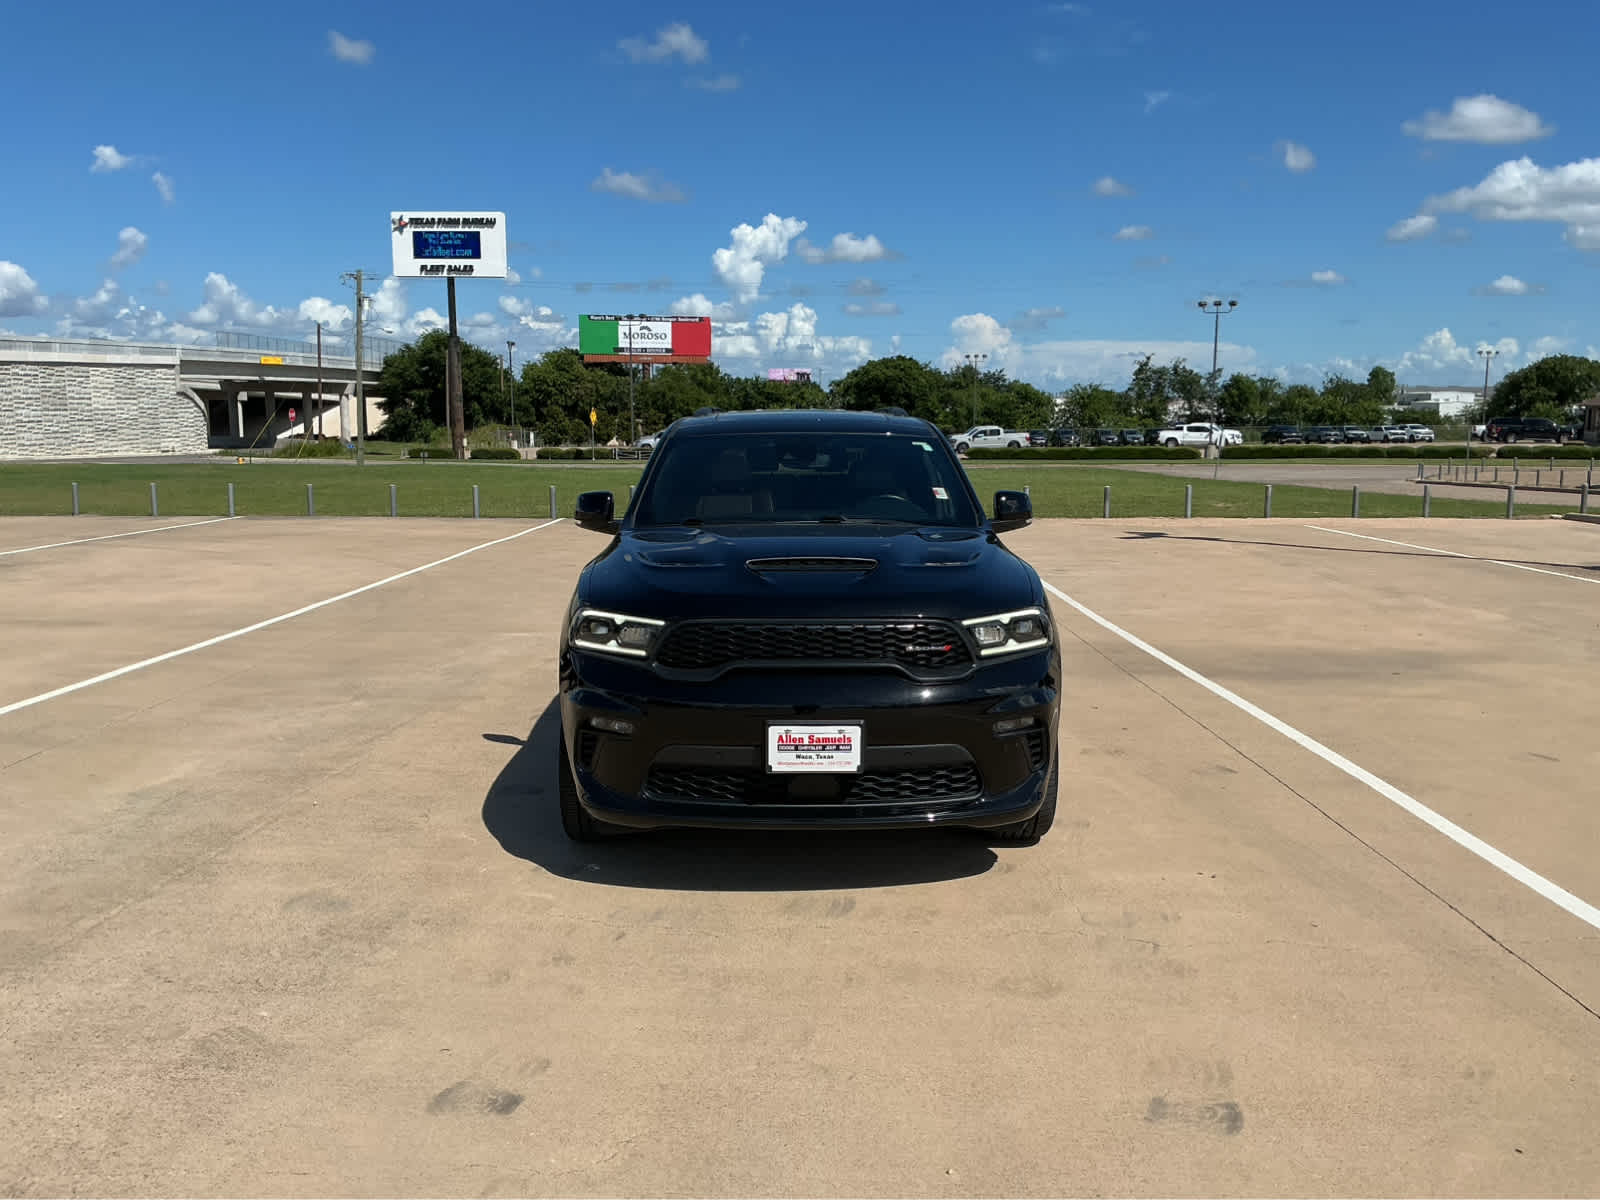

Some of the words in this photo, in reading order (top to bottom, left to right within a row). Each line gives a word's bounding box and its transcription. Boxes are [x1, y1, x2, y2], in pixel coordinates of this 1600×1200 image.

[623, 332, 667, 340] MOROSO
[777, 734, 804, 744] Allen
[808, 734, 852, 744] Samuels
